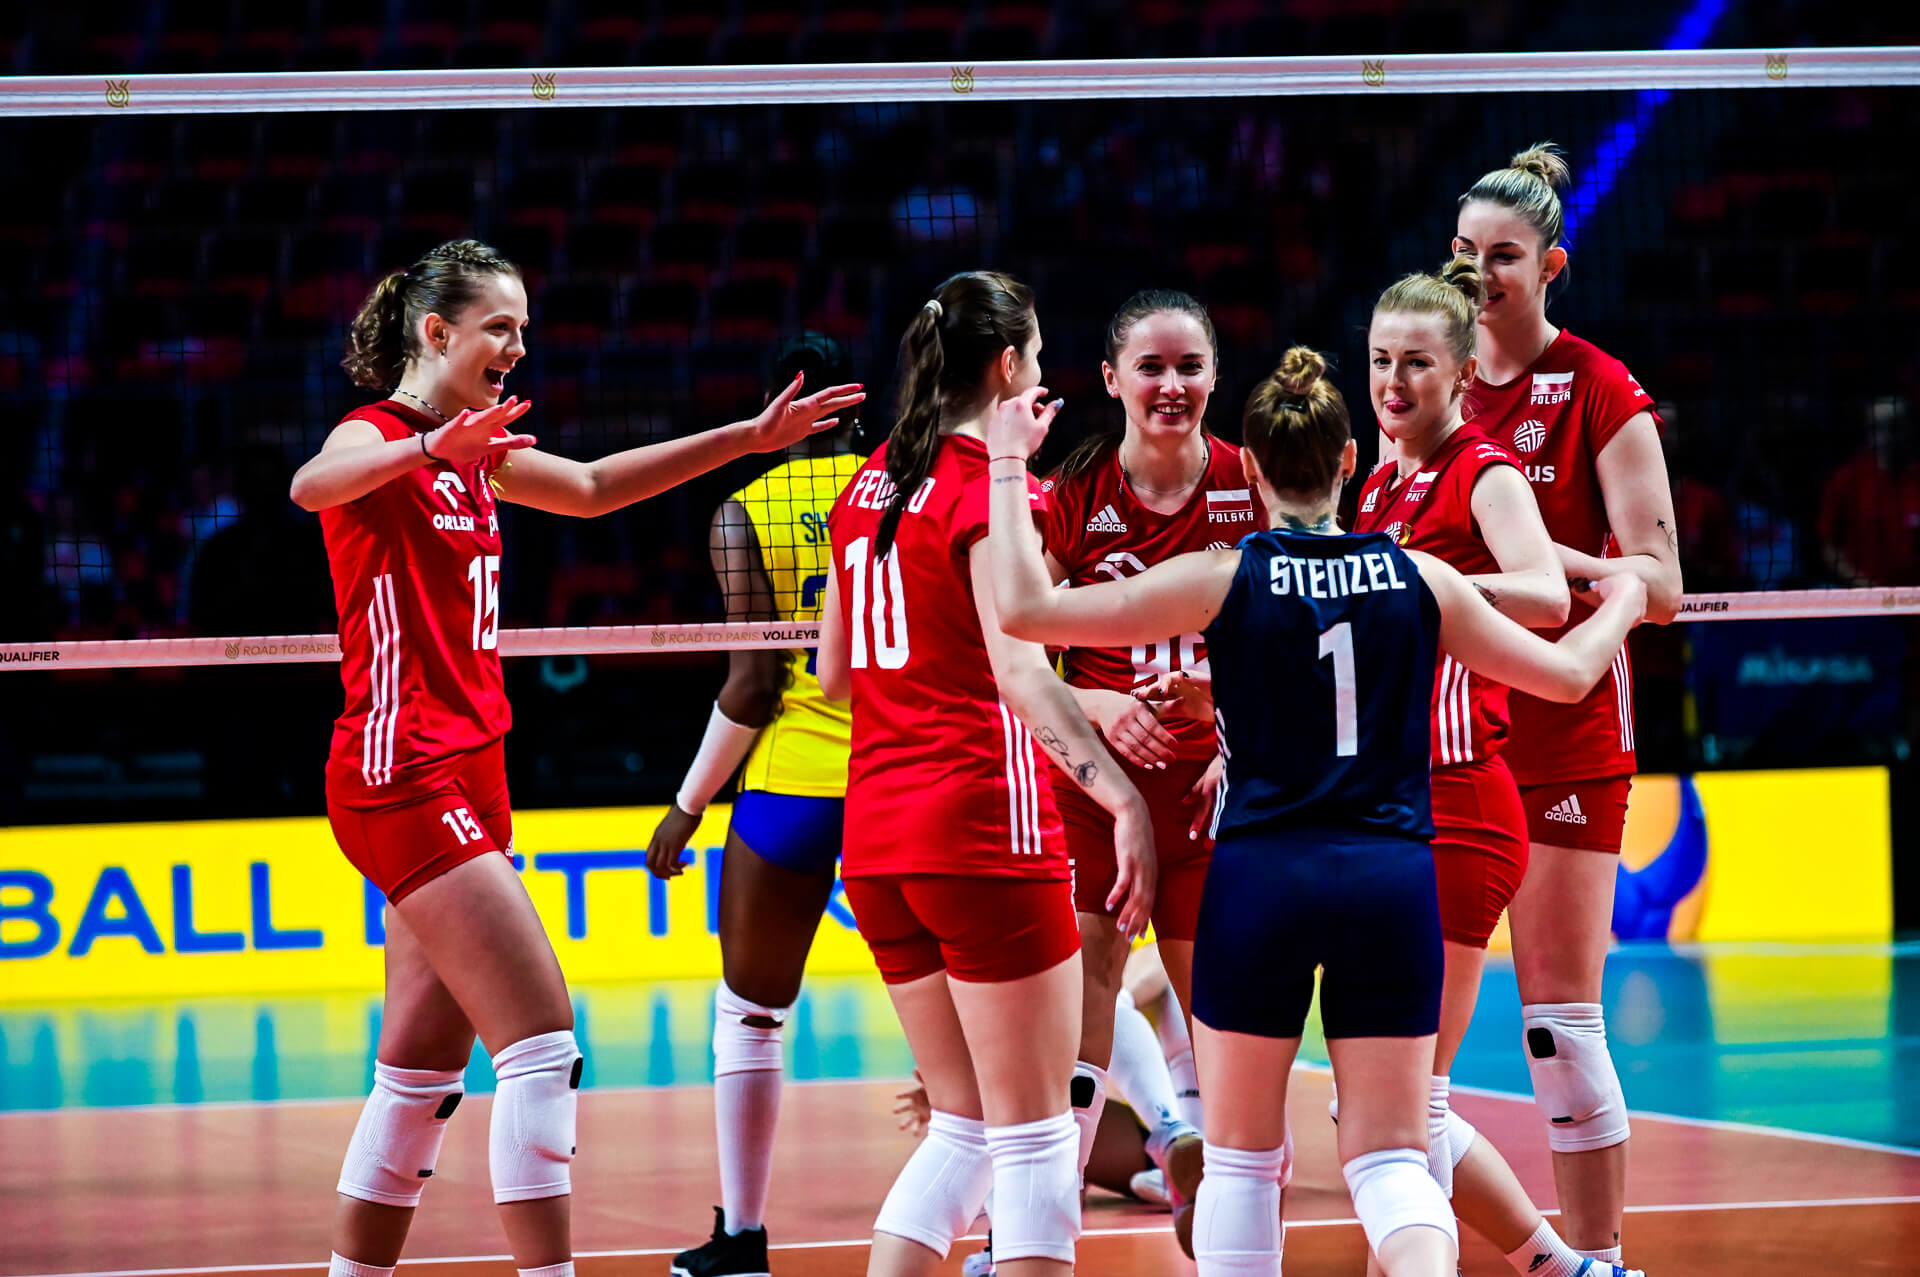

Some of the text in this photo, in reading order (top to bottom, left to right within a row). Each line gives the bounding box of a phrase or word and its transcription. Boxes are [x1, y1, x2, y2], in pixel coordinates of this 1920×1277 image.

[1531, 391, 1571, 405] POLSKA
[1524, 464, 1556, 482] us
[433, 514, 475, 532] ORLEN
[1208, 511, 1254, 523] POLSKA
[1086, 521, 1128, 533] adidas
[1270, 552, 1407, 599] STENZEL
[468, 555, 500, 651] 15
[845, 536, 910, 670] 10
[1679, 601, 1729, 613] UALIFIER
[669, 630, 819, 644] ROAD TO PARIS VOLLEYB
[243, 643, 335, 656] ROAD TO PARIS
[1318, 621, 1358, 757] 1
[441, 807, 484, 846] 15
[1544, 810, 1588, 825] adidas
[0, 861, 324, 960] BALL
